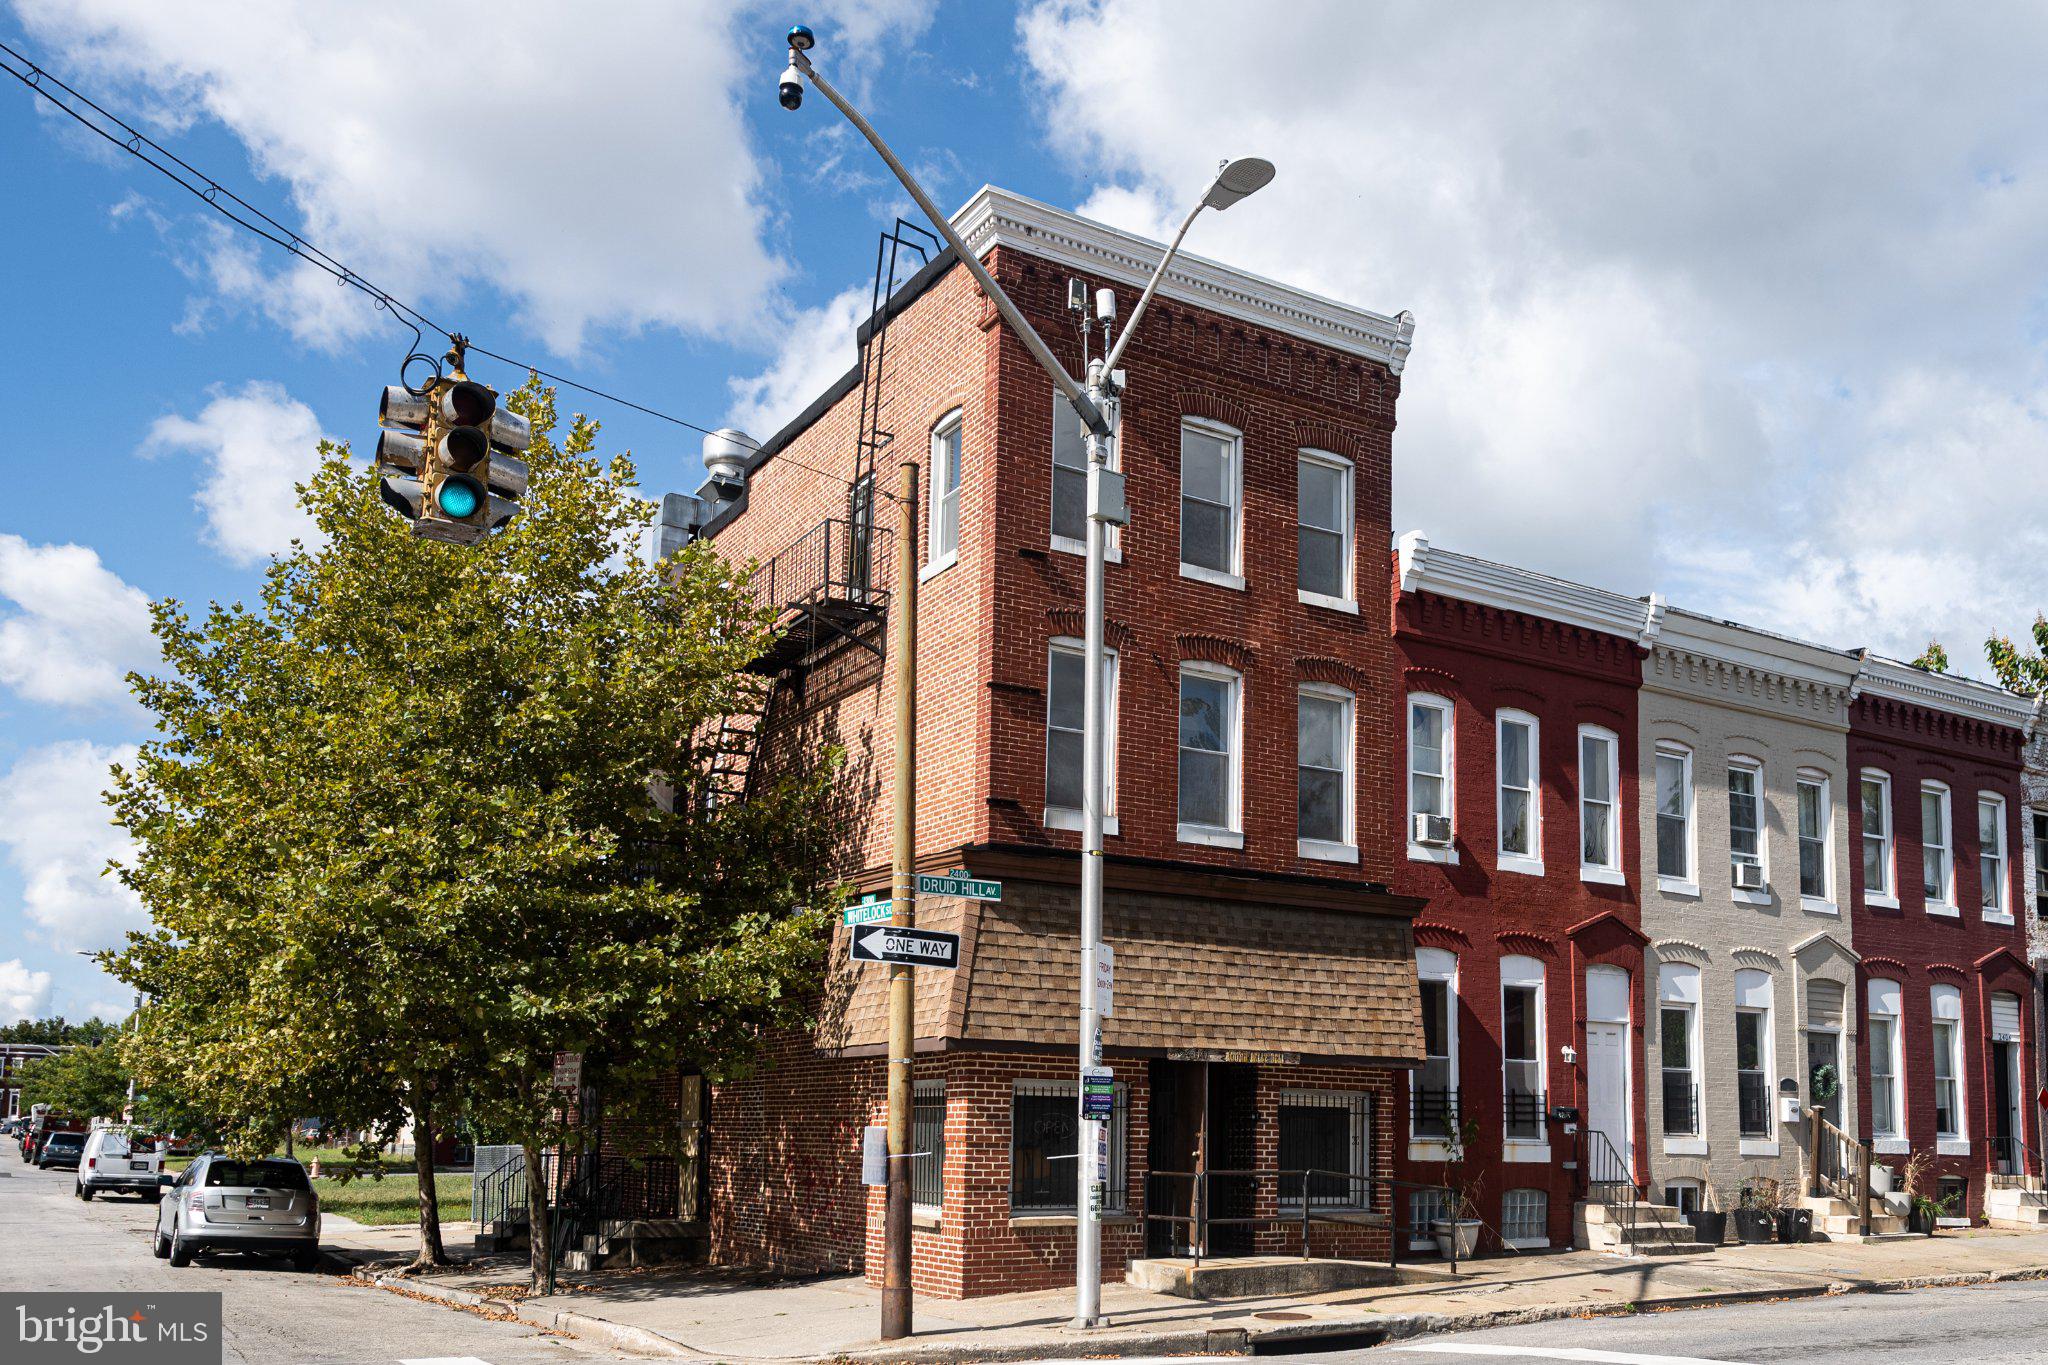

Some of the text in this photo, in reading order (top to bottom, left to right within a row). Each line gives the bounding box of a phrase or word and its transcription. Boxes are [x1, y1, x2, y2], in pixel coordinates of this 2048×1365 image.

[950, 870, 968, 879] 2400
[923, 878, 957, 894] DRUID
[961, 881, 986, 897] HILL
[847, 903, 886, 924] WHITELOCK
[885, 937, 948, 957] ONE WAY
[1098, 961, 1111, 974] FRIDAY
[556, 1053, 565, 1065] NO
